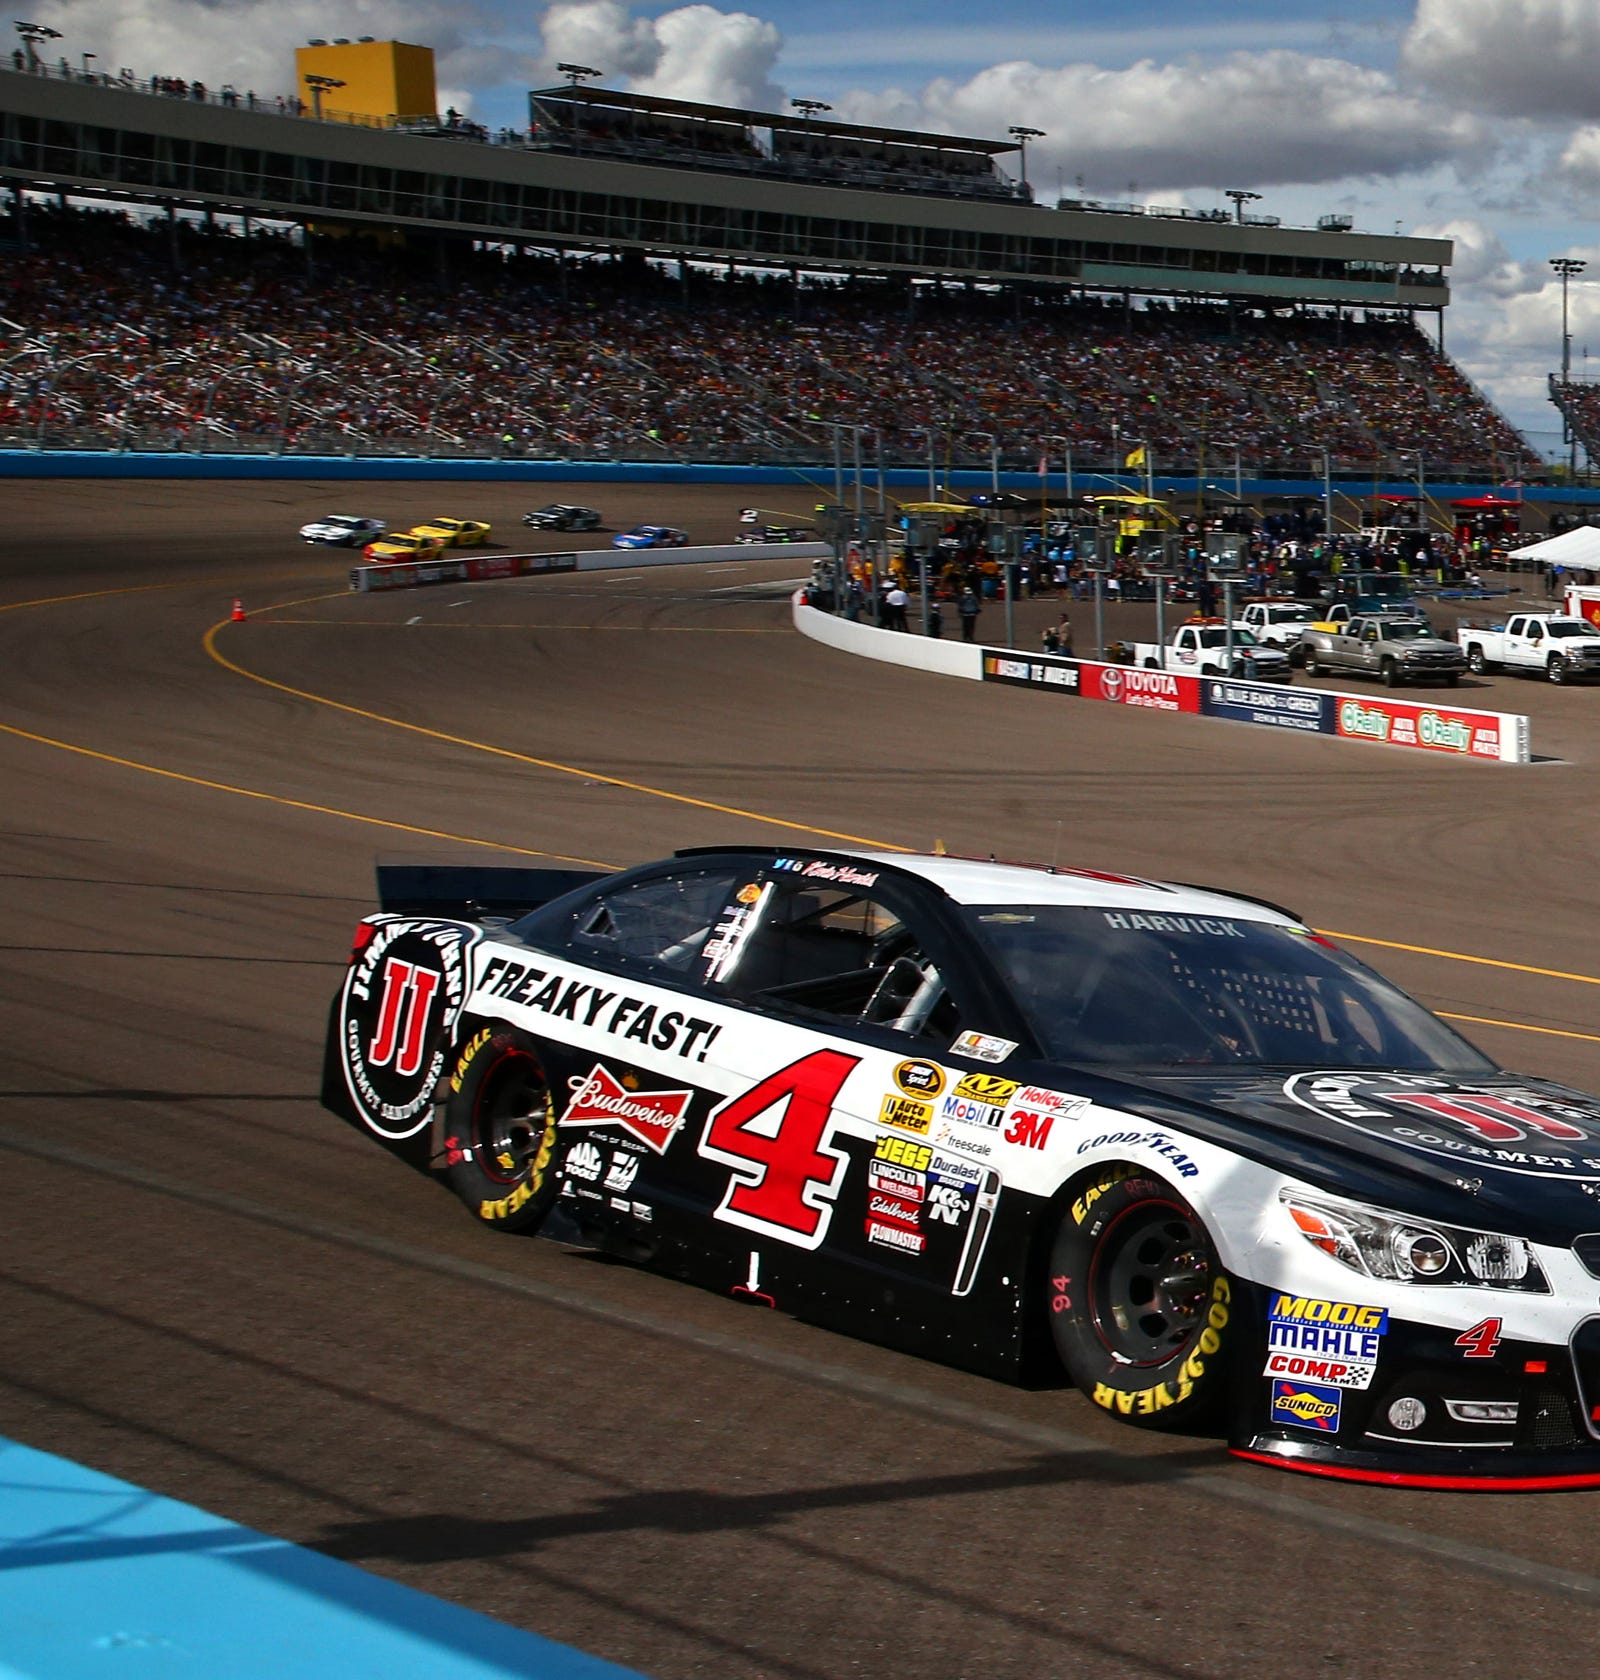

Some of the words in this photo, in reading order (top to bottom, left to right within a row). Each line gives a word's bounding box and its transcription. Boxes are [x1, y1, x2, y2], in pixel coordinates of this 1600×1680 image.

[1124, 671, 1179, 696] TOYOTA
[1341, 702, 1390, 741] O'Reilly
[1419, 712, 1472, 753] O'Reilly
[1104, 912, 1245, 938] HARVICK
[368, 956, 441, 1077] JJ
[476, 957, 617, 1027] FREAKY
[607, 997, 723, 1064] FAST!
[450, 1027, 492, 1093] EAGLE
[568, 1075, 687, 1131] Budweiser
[896, 1100, 925, 1117] Auto
[942, 1096, 987, 1123] Mobil
[1020, 1087, 1064, 1112] Holley
[892, 1110, 928, 1130] Meter
[1004, 1110, 1055, 1151] 3M
[1372, 1092, 1588, 1142] JJ
[566, 1142, 602, 1173] MAC
[697, 1048, 863, 1250] 4
[874, 1136, 933, 1172] JEGS
[948, 1135, 992, 1157] freescale
[1393, 1127, 1575, 1169] GOURMET
[565, 1163, 600, 1181] TOOLS
[872, 1163, 916, 1186] LINCOLN
[932, 1156, 982, 1180] Duralast
[880, 1178, 919, 1199] WELDERS
[868, 1222, 925, 1251] FLOWMASTER
[1273, 1295, 1384, 1329] MOOG
[1269, 1322, 1378, 1359] MAHLE
[1454, 1316, 1503, 1358] 4
[1269, 1355, 1347, 1379] COMP
[1321, 1375, 1361, 1386] CAMS
[1277, 1397, 1335, 1416] SUNOCO
